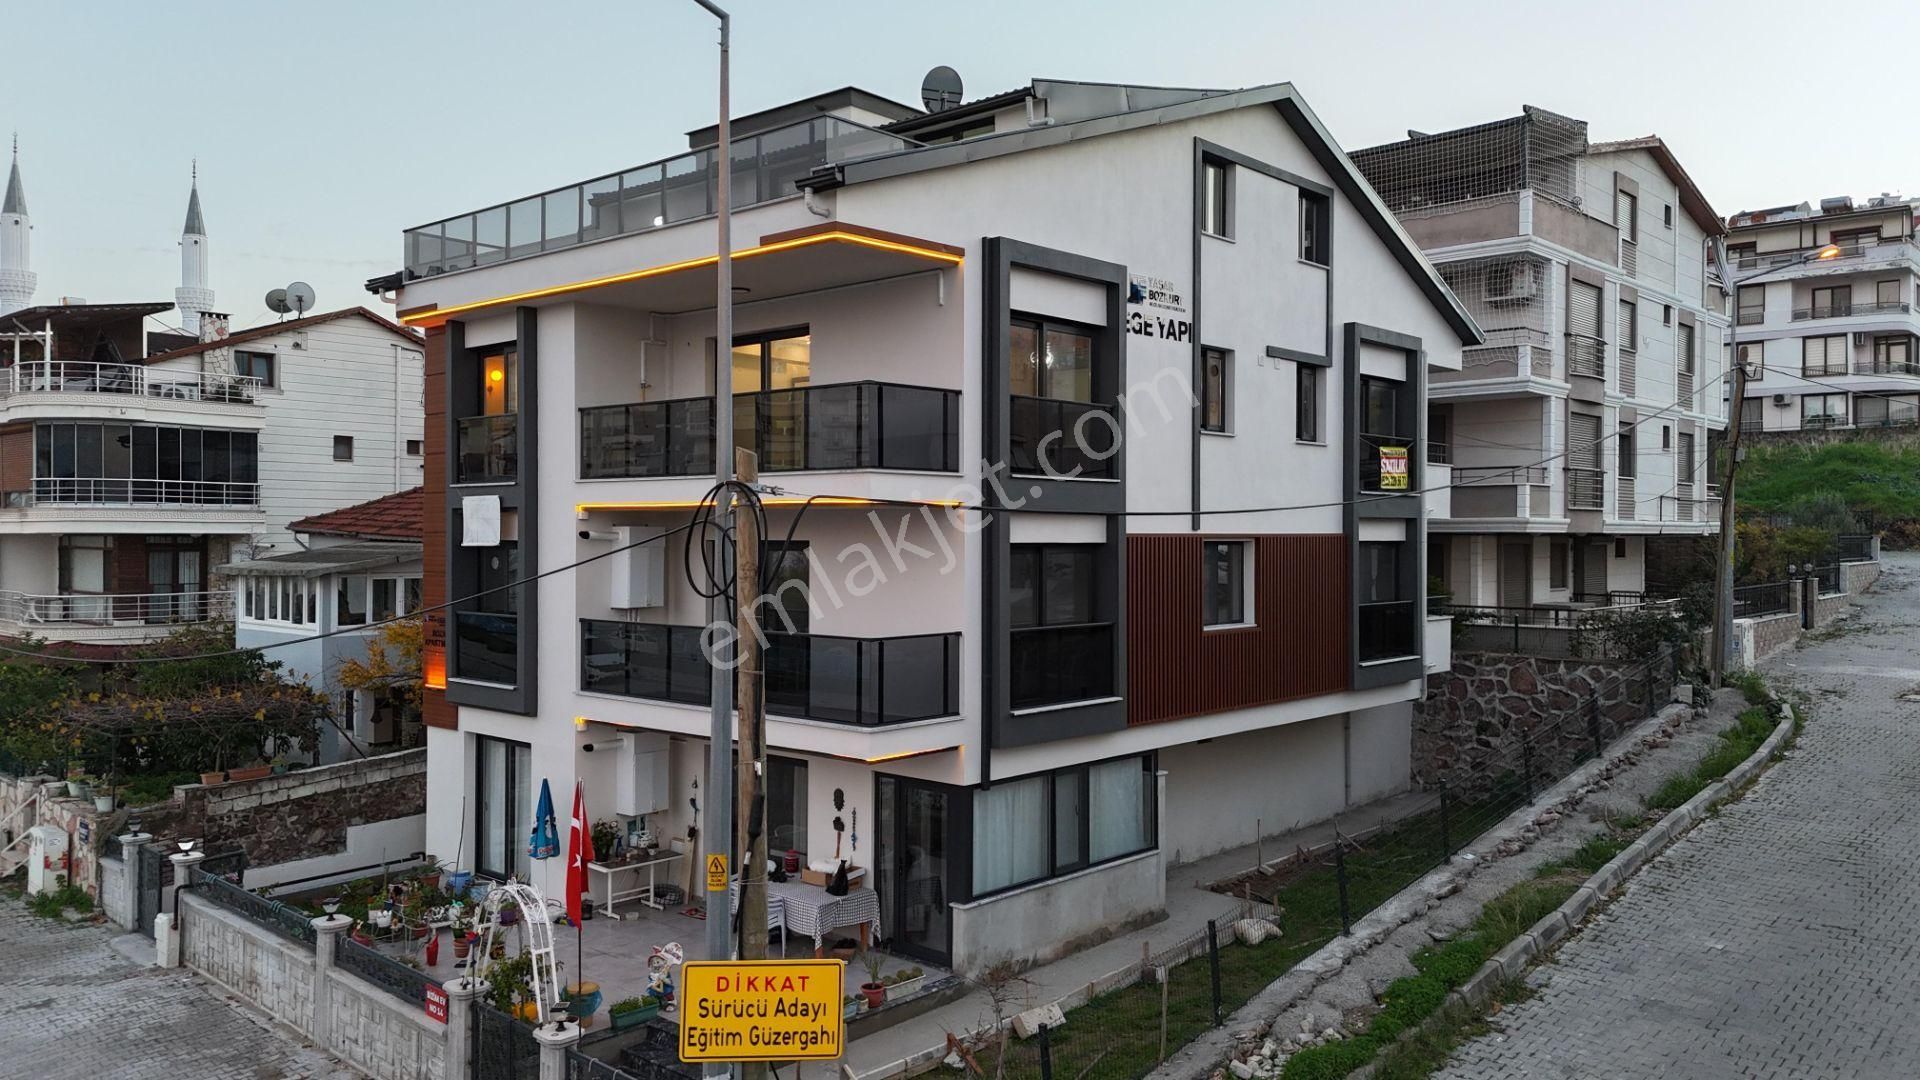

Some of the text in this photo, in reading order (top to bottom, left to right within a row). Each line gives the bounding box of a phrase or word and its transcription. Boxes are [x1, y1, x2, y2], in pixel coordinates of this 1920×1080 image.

[1156, 316, 1192, 344] YAPI
[716, 972, 810, 993] DİKKAT
[698, 997, 827, 1023] Sürücü Adayı
[687, 1025, 835, 1052] Eğitim Güzergahı
